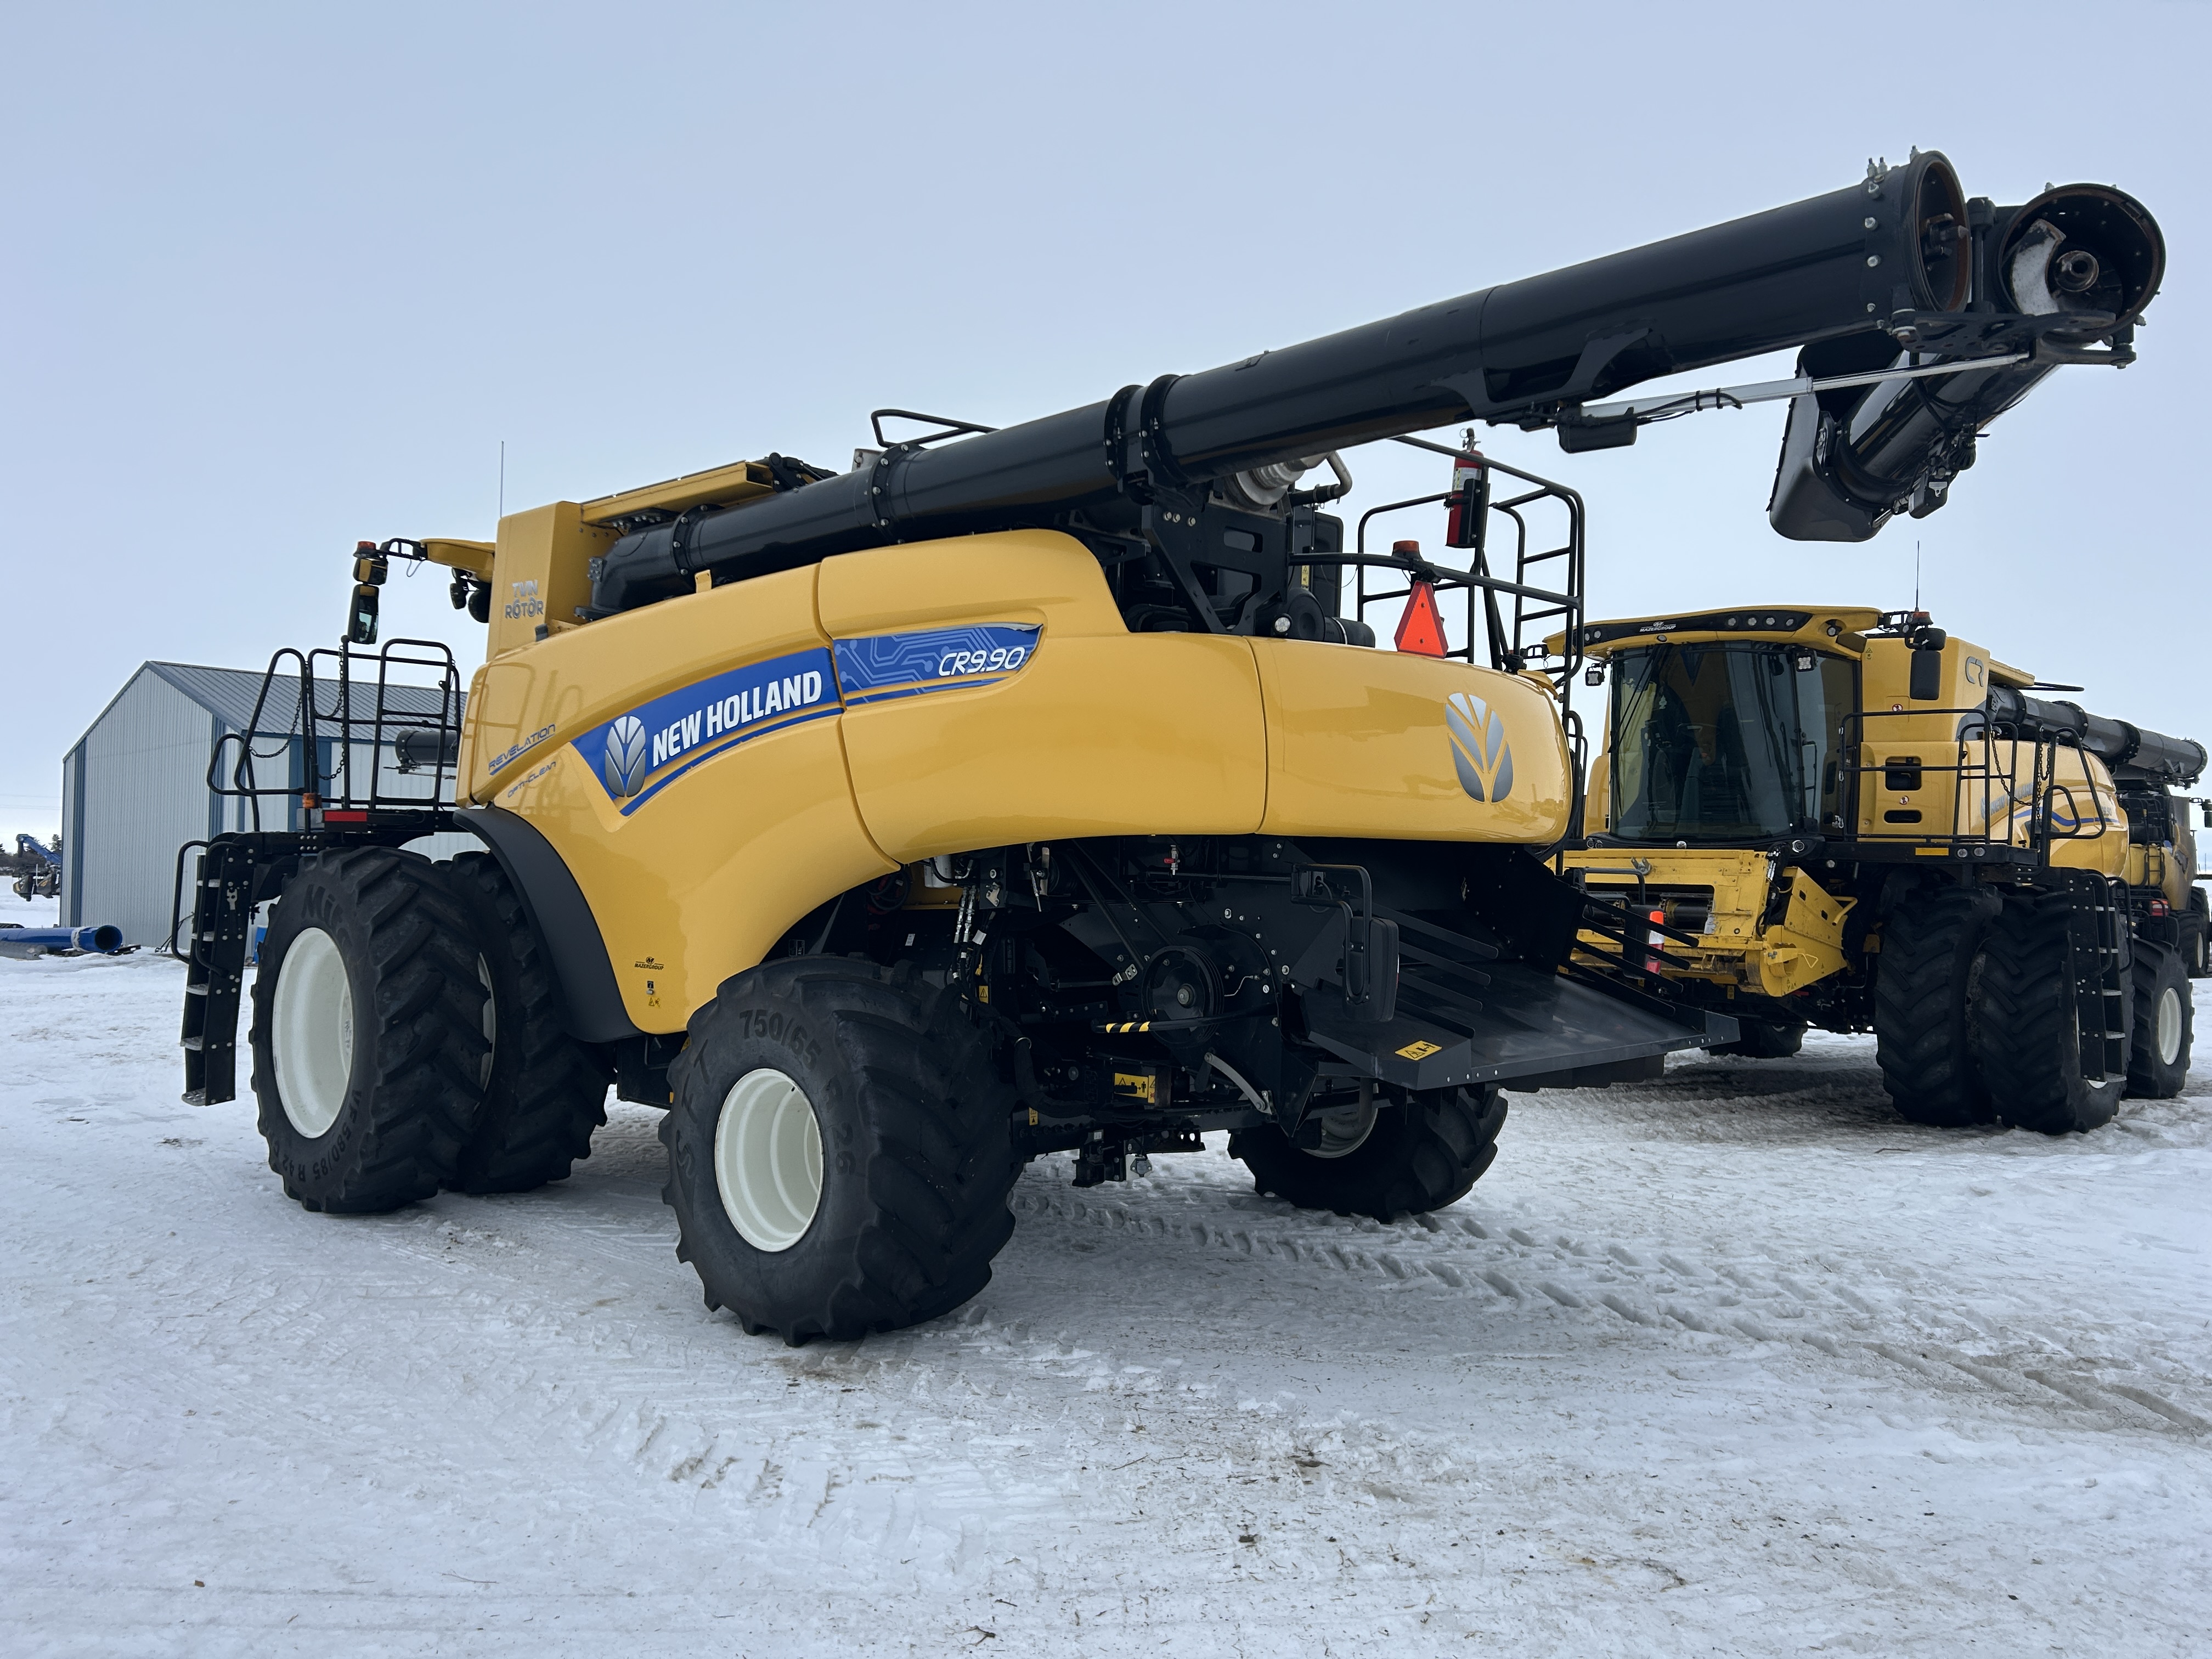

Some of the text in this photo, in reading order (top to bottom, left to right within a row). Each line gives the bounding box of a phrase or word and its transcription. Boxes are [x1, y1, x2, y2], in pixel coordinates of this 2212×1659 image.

[512, 579, 538, 597] TWIN
[505, 596, 544, 619] ROTOR
[938, 647, 1025, 676] CR9.90
[1965, 656, 1984, 687] CR
[653, 670, 822, 768] NEW HOLLAND
[488, 724, 556, 771] REVELATION
[507, 761, 556, 798] OPTI-CLEAN
[740, 1009, 822, 1070] 750/65
[313, 1122, 352, 1181] 580/85
